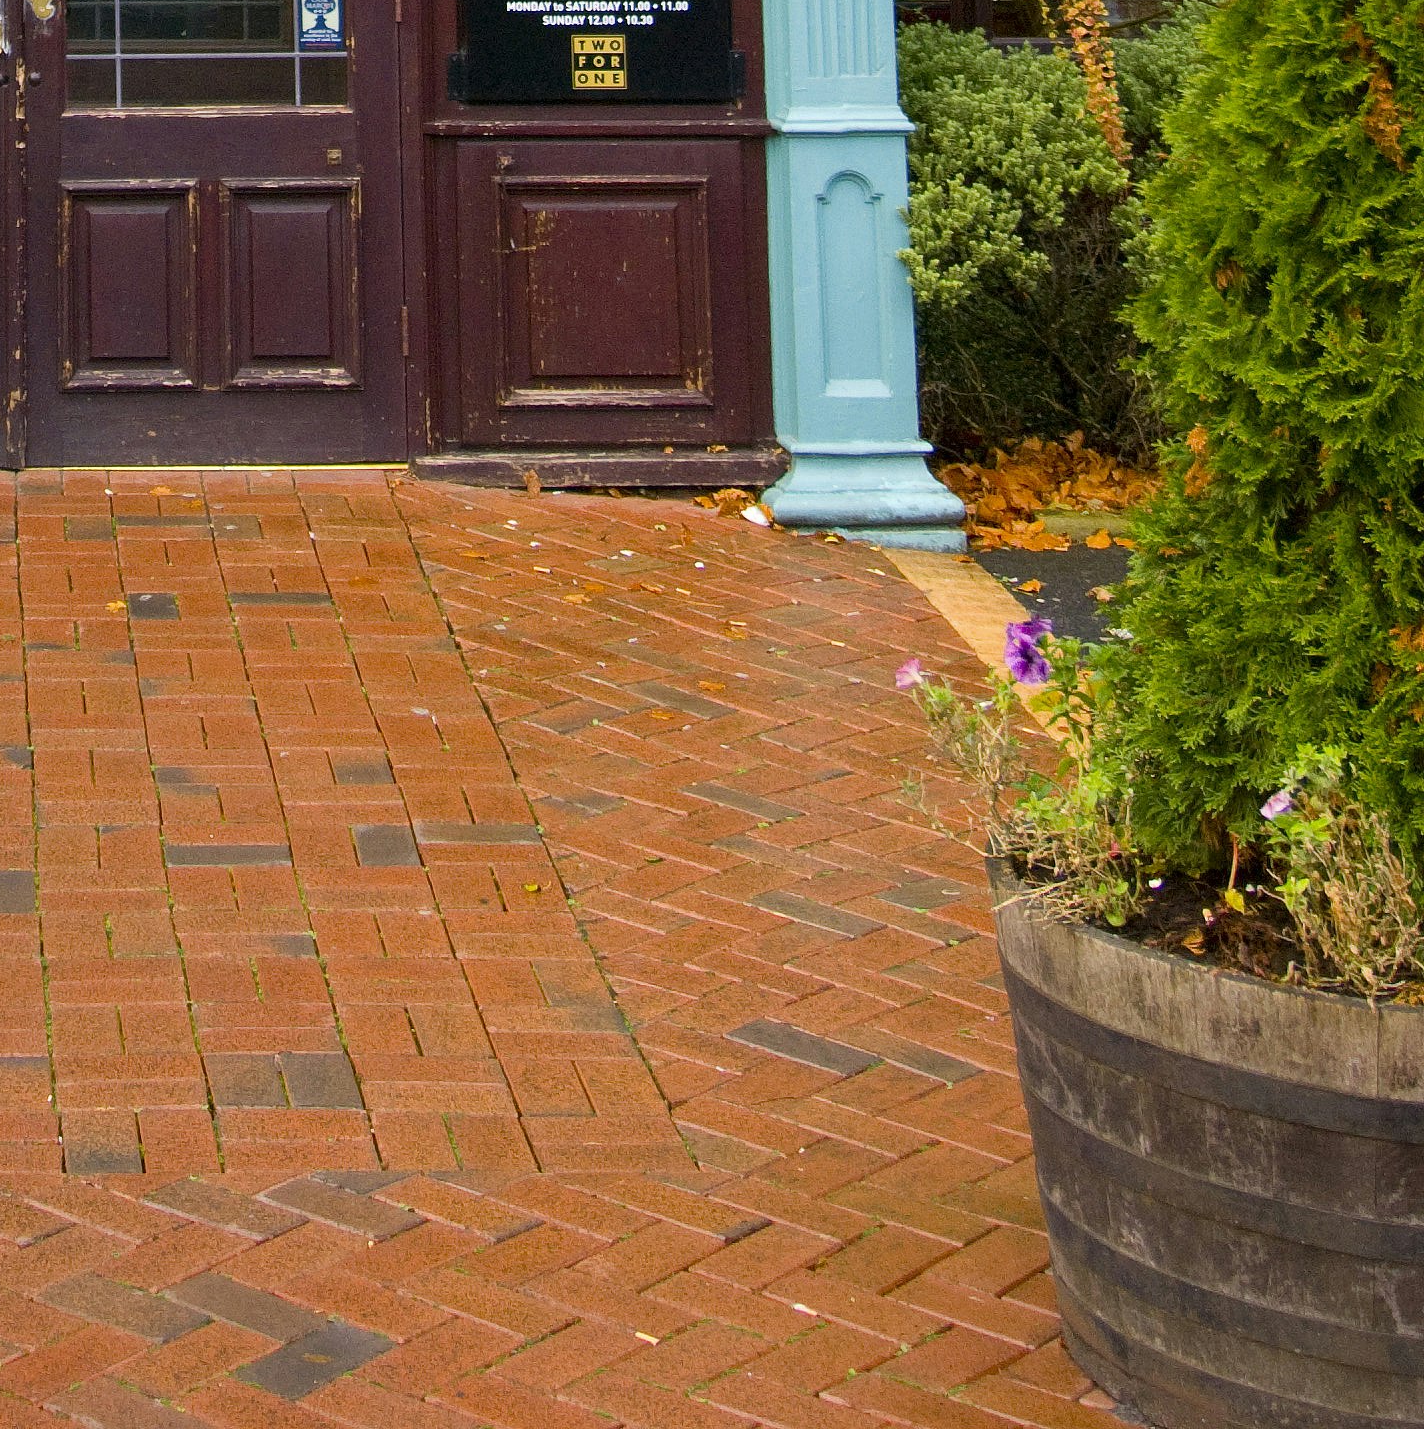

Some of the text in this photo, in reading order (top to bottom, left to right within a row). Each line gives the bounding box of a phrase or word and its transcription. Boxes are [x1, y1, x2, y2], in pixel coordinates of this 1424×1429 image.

[507, 1, 689, 11] MONDAY to SATURDAY 11.00 11.00
[543, 15, 653, 25] SUNDAY 12.00 10.30
[578, 40, 621, 51] TWO
[578, 57, 620, 67] FOR
[578, 73, 620, 84] ONE
